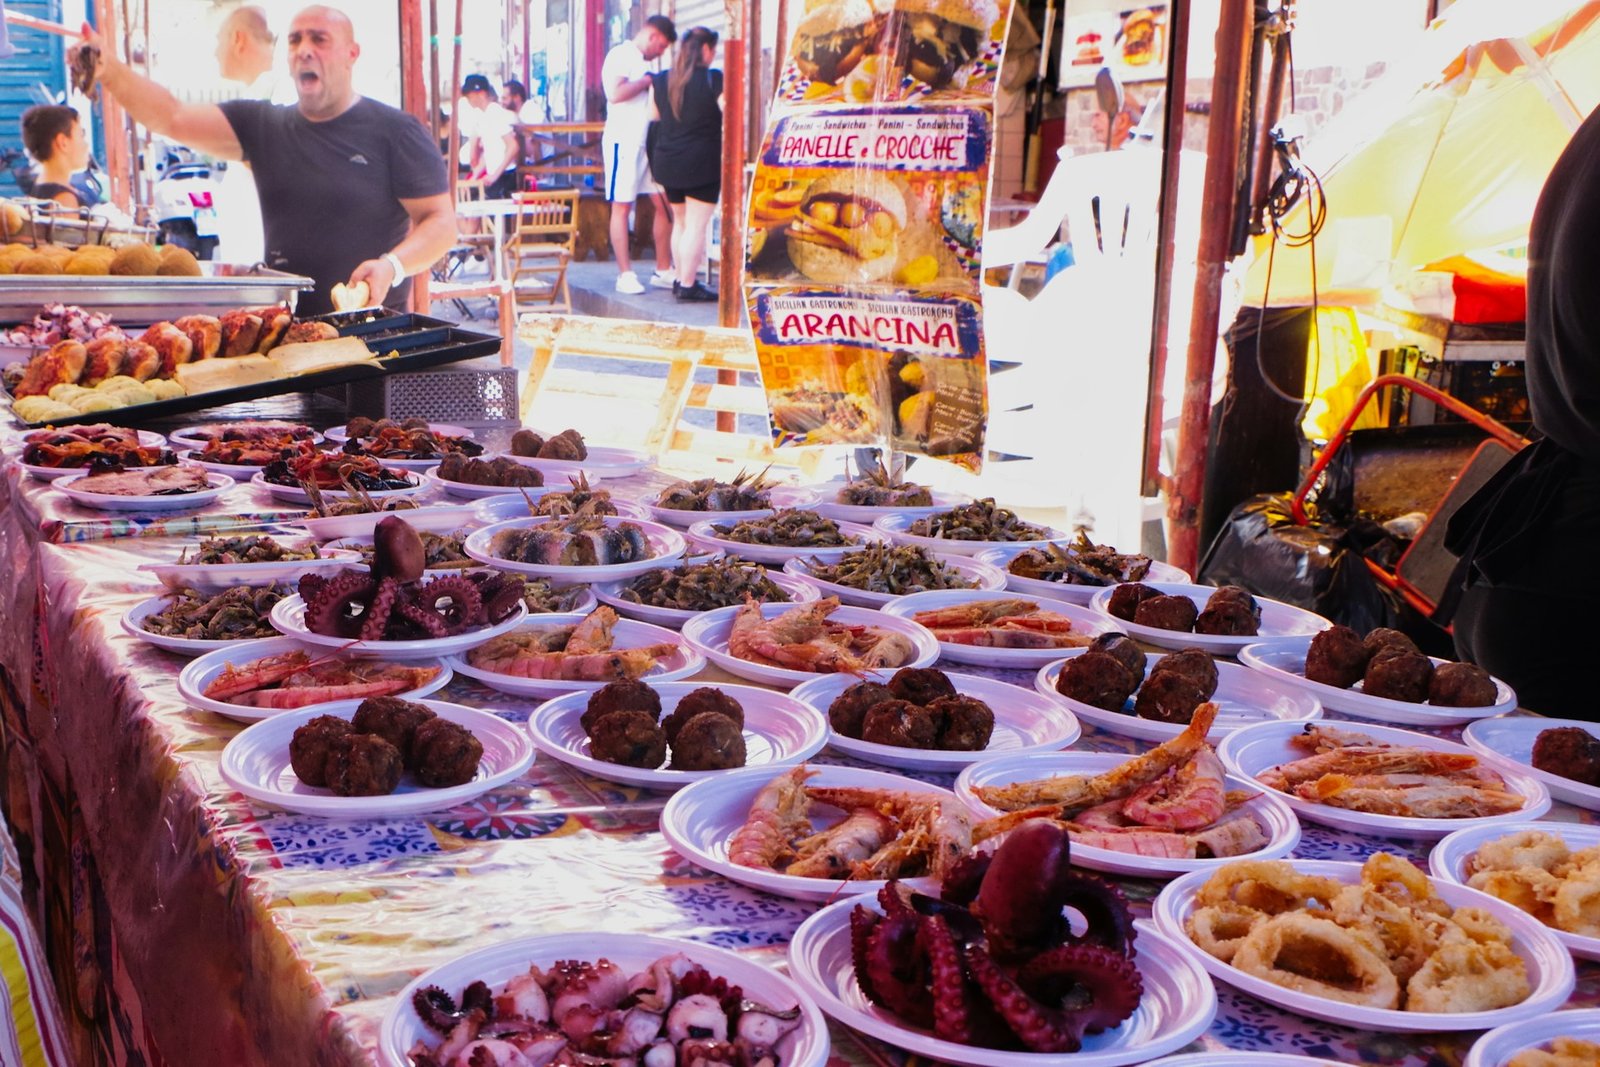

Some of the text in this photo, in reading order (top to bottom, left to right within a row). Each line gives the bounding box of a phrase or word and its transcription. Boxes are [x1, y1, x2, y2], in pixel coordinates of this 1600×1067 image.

[791, 117, 964, 131] Panini Sandwiches Panini Sandwiches
[783, 135, 859, 158] PANELLE
[774, 300, 954, 319] SICILIAN GASTRONOMY SICILIAN GASTRONOMY
[780, 313, 956, 348] ARANCINA
